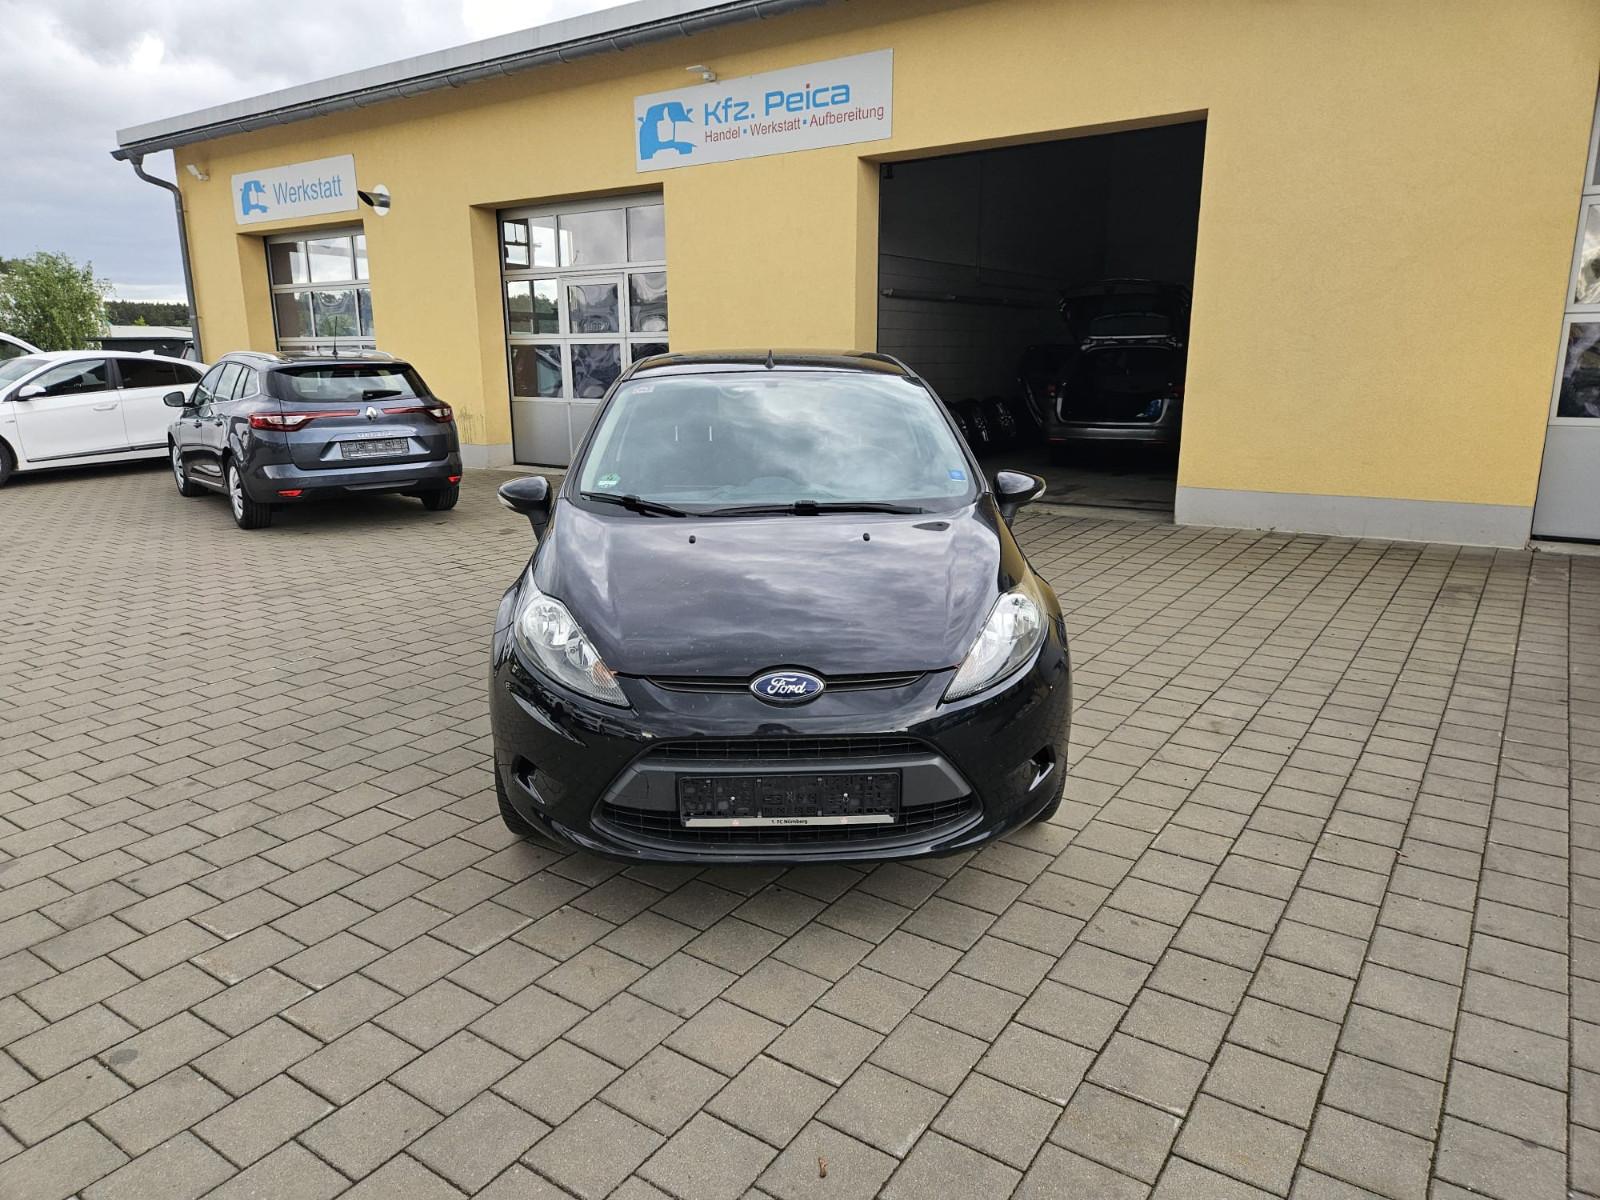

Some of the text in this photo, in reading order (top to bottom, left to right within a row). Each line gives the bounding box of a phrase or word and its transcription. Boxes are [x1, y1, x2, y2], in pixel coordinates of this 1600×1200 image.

[704, 83, 850, 126] Kfz. Peica
[704, 106, 885, 143] Handel Werkstatt Aufbereitung
[273, 174, 343, 205] Werkstatt
[767, 677, 807, 694] Ford
